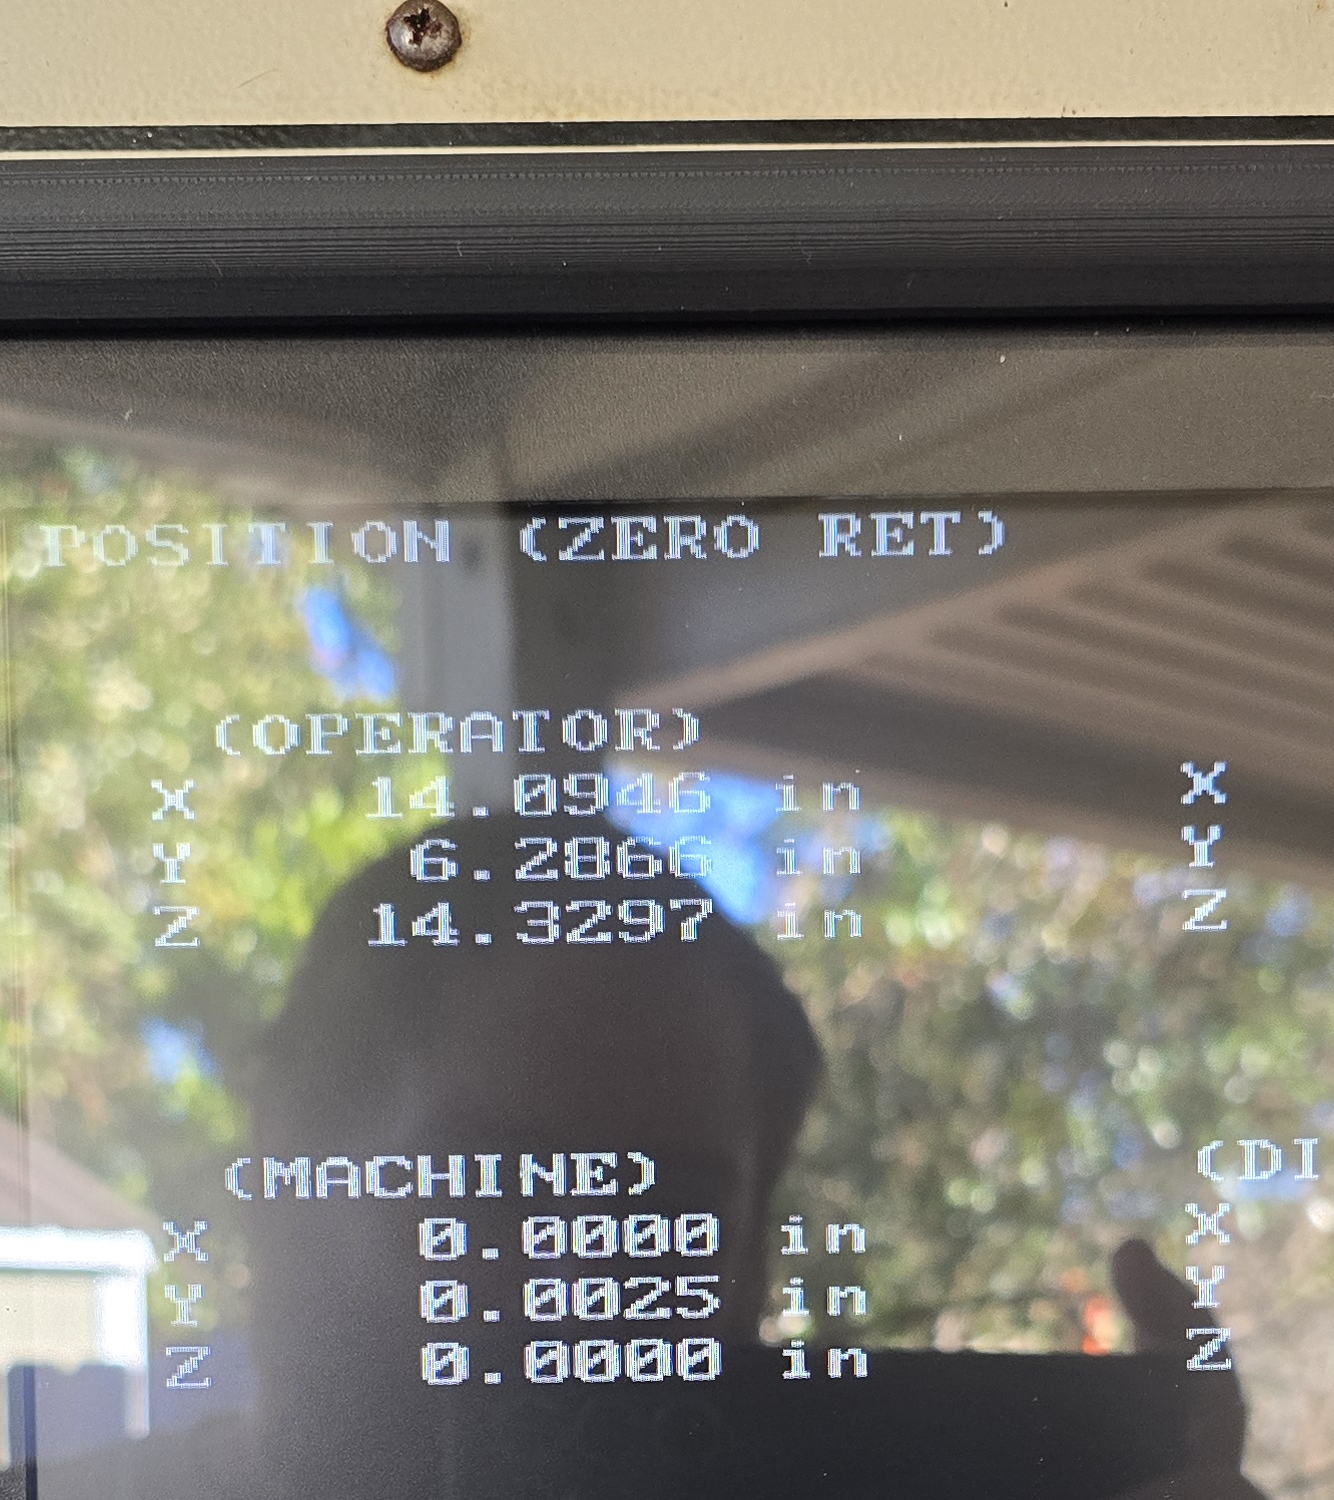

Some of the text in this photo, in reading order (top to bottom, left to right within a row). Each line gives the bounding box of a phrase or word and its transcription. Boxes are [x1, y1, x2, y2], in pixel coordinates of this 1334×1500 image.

[41, 509, 1007, 569] POSITION (ZERO RET)
[215, 707, 701, 757] (OPERATOR)
[150, 771, 862, 821] X 14.0946 in
[1180, 760, 1228, 804] X
[150, 834, 862, 885] Y 6.2866 in
[1181, 825, 1223, 868] Y
[153, 898, 863, 949] Z 14.3297 in
[1182, 888, 1228, 931] Z
[225, 1152, 657, 1199] (MACHINE)
[162, 1212, 868, 1262] X 0.0000 in
[1185, 1201, 1230, 1244] X
[164, 1275, 869, 1327] Y 0.0025 in
[1186, 1264, 1227, 1308] Y
[165, 1337, 869, 1389] Z 0.0000 in
[1186, 1327, 1232, 1371] Z
